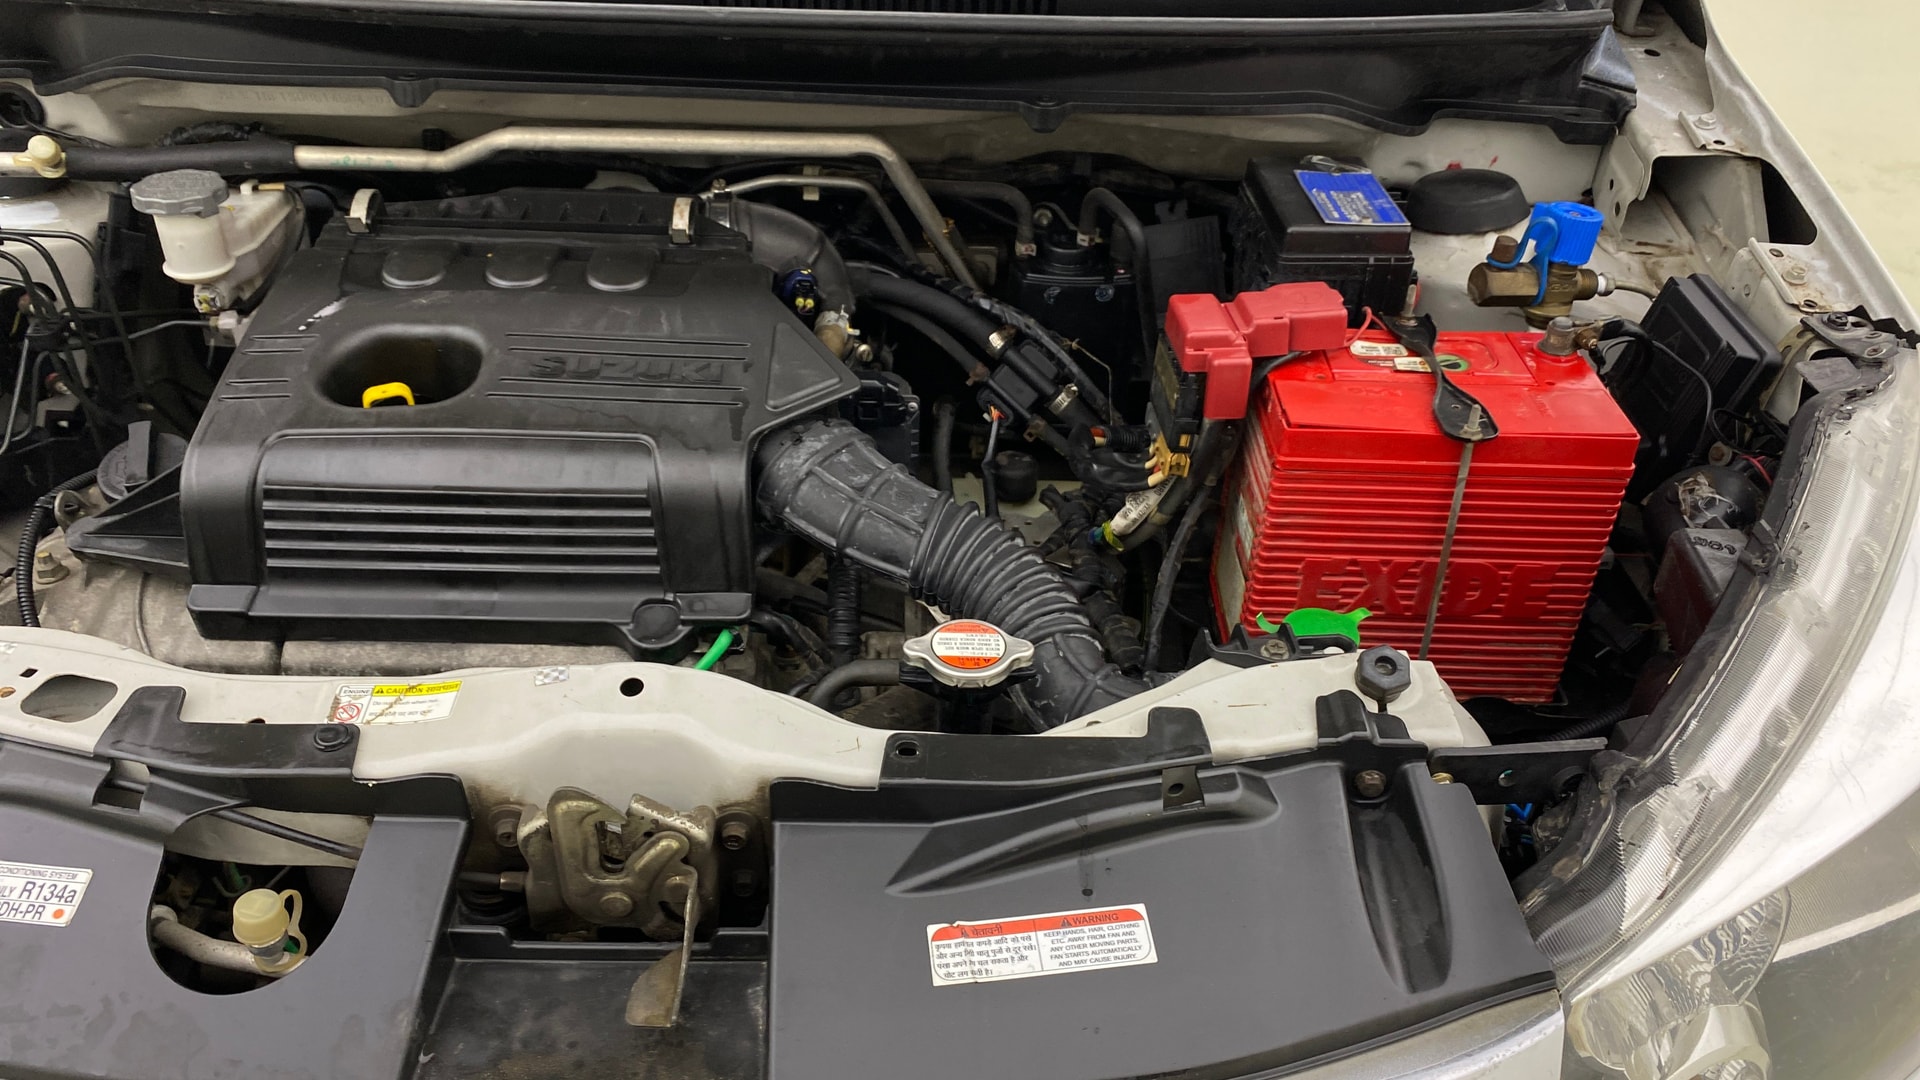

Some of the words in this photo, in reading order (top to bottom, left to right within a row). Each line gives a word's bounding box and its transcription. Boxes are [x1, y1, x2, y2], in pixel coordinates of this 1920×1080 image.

[528, 356, 723, 384] SUZUKI
[1294, 557, 1561, 618] EXIDE
[48, 871, 79, 880] SYSTEM
[18, 881, 77, 904] R134a
[1072, 913, 1119, 925] WARNING
[972, 926, 1002, 937] चेतावनी
[1107, 922, 1140, 931] CLOTHING
[1087, 933, 1105, 941] FROM
[1065, 943, 1088, 951] OTHER
[1090, 940, 1115, 949] MOVING
[1064, 950, 1090, 958] STARTS
[1091, 945, 1142, 955] AUTOMATICALLY
[1090, 956, 1112, 964] CAUSE
